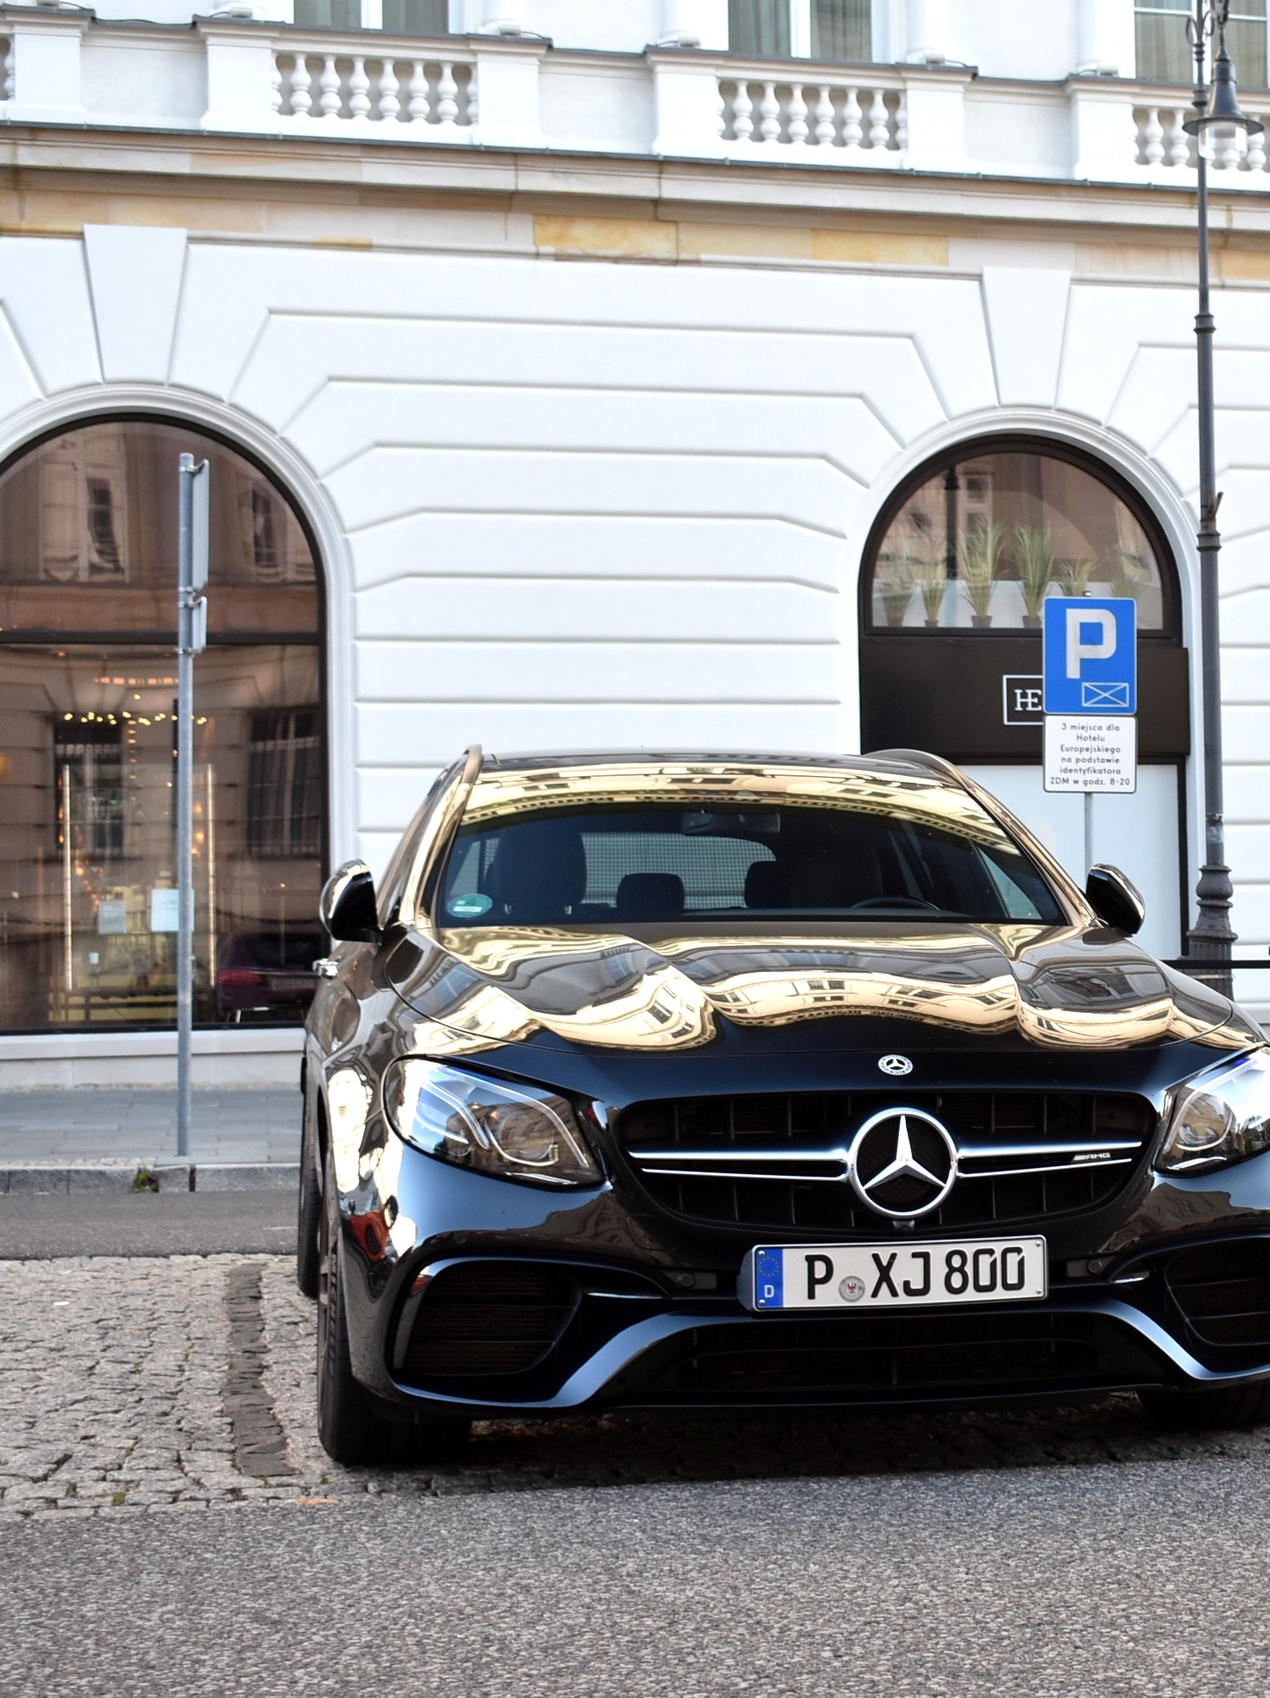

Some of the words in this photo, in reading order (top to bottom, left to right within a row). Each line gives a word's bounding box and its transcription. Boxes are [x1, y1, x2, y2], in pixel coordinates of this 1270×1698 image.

[1066, 609, 1117, 679] P
[1014, 689, 1042, 711] HE
[1061, 722, 1067, 731] 3
[1070, 723, 1103, 732] miejsca
[1106, 723, 1120, 732] dla
[1076, 734, 1105, 742] Hotelu
[1060, 744, 1121, 755] Europejskiego
[1075, 756, 1120, 765] podstawie
[1060, 766, 1121, 776] identyfikatora
[1050, 777, 1070, 785] ZDM
[1083, 778, 1107, 787] godz.
[1110, 778, 1130, 786] 8-20
[1084, 1152, 1112, 1160] AMG
[805, 1254, 834, 1300] P
[871, 1252, 932, 1298] XJ
[944, 1246, 1026, 1295] 800
[763, 1284, 774, 1298] D
